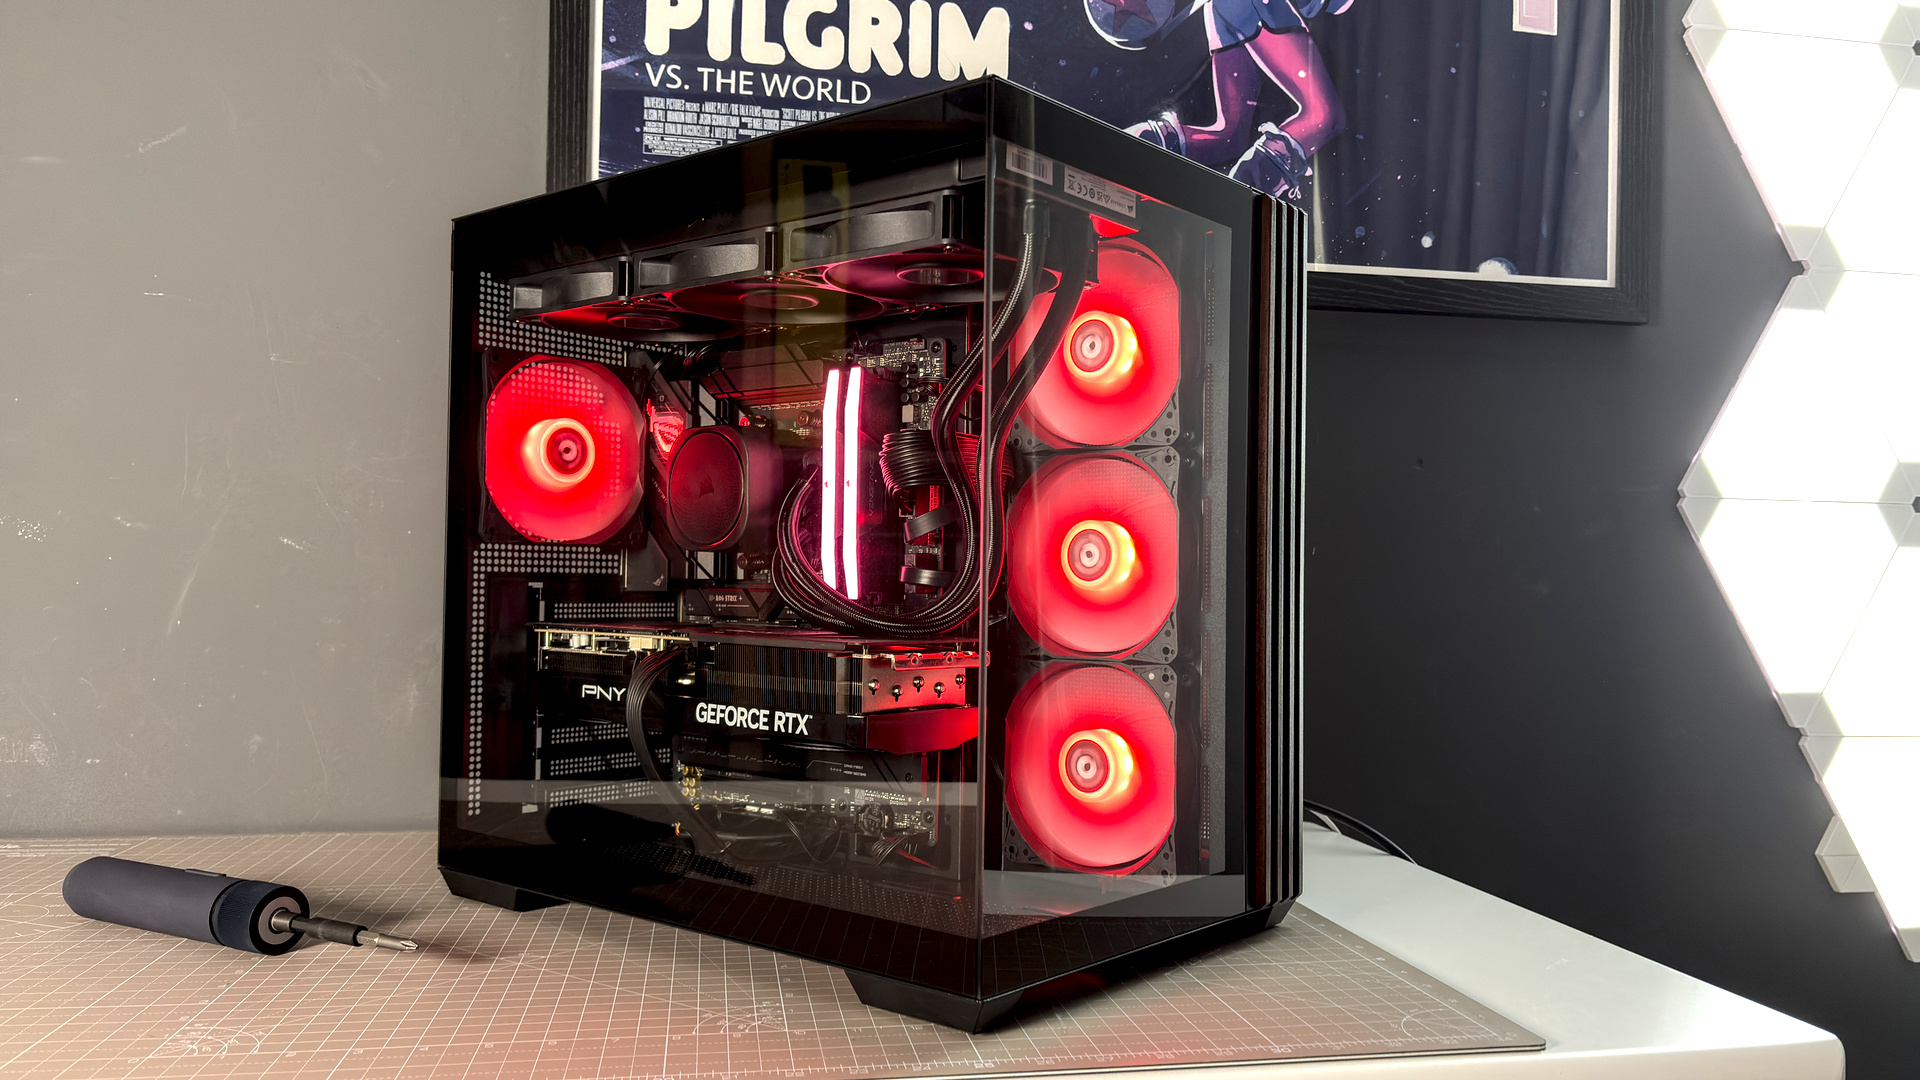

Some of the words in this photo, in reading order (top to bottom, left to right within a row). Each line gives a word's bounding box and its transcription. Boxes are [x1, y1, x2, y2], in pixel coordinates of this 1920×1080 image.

[643, 0, 1010, 80] PILGRIM
[645, 62, 690, 91] VS.
[697, 67, 754, 96] THE
[761, 72, 872, 105] WORLD
[582, 684, 626, 702] PNY
[695, 702, 770, 731] GEFORCE
